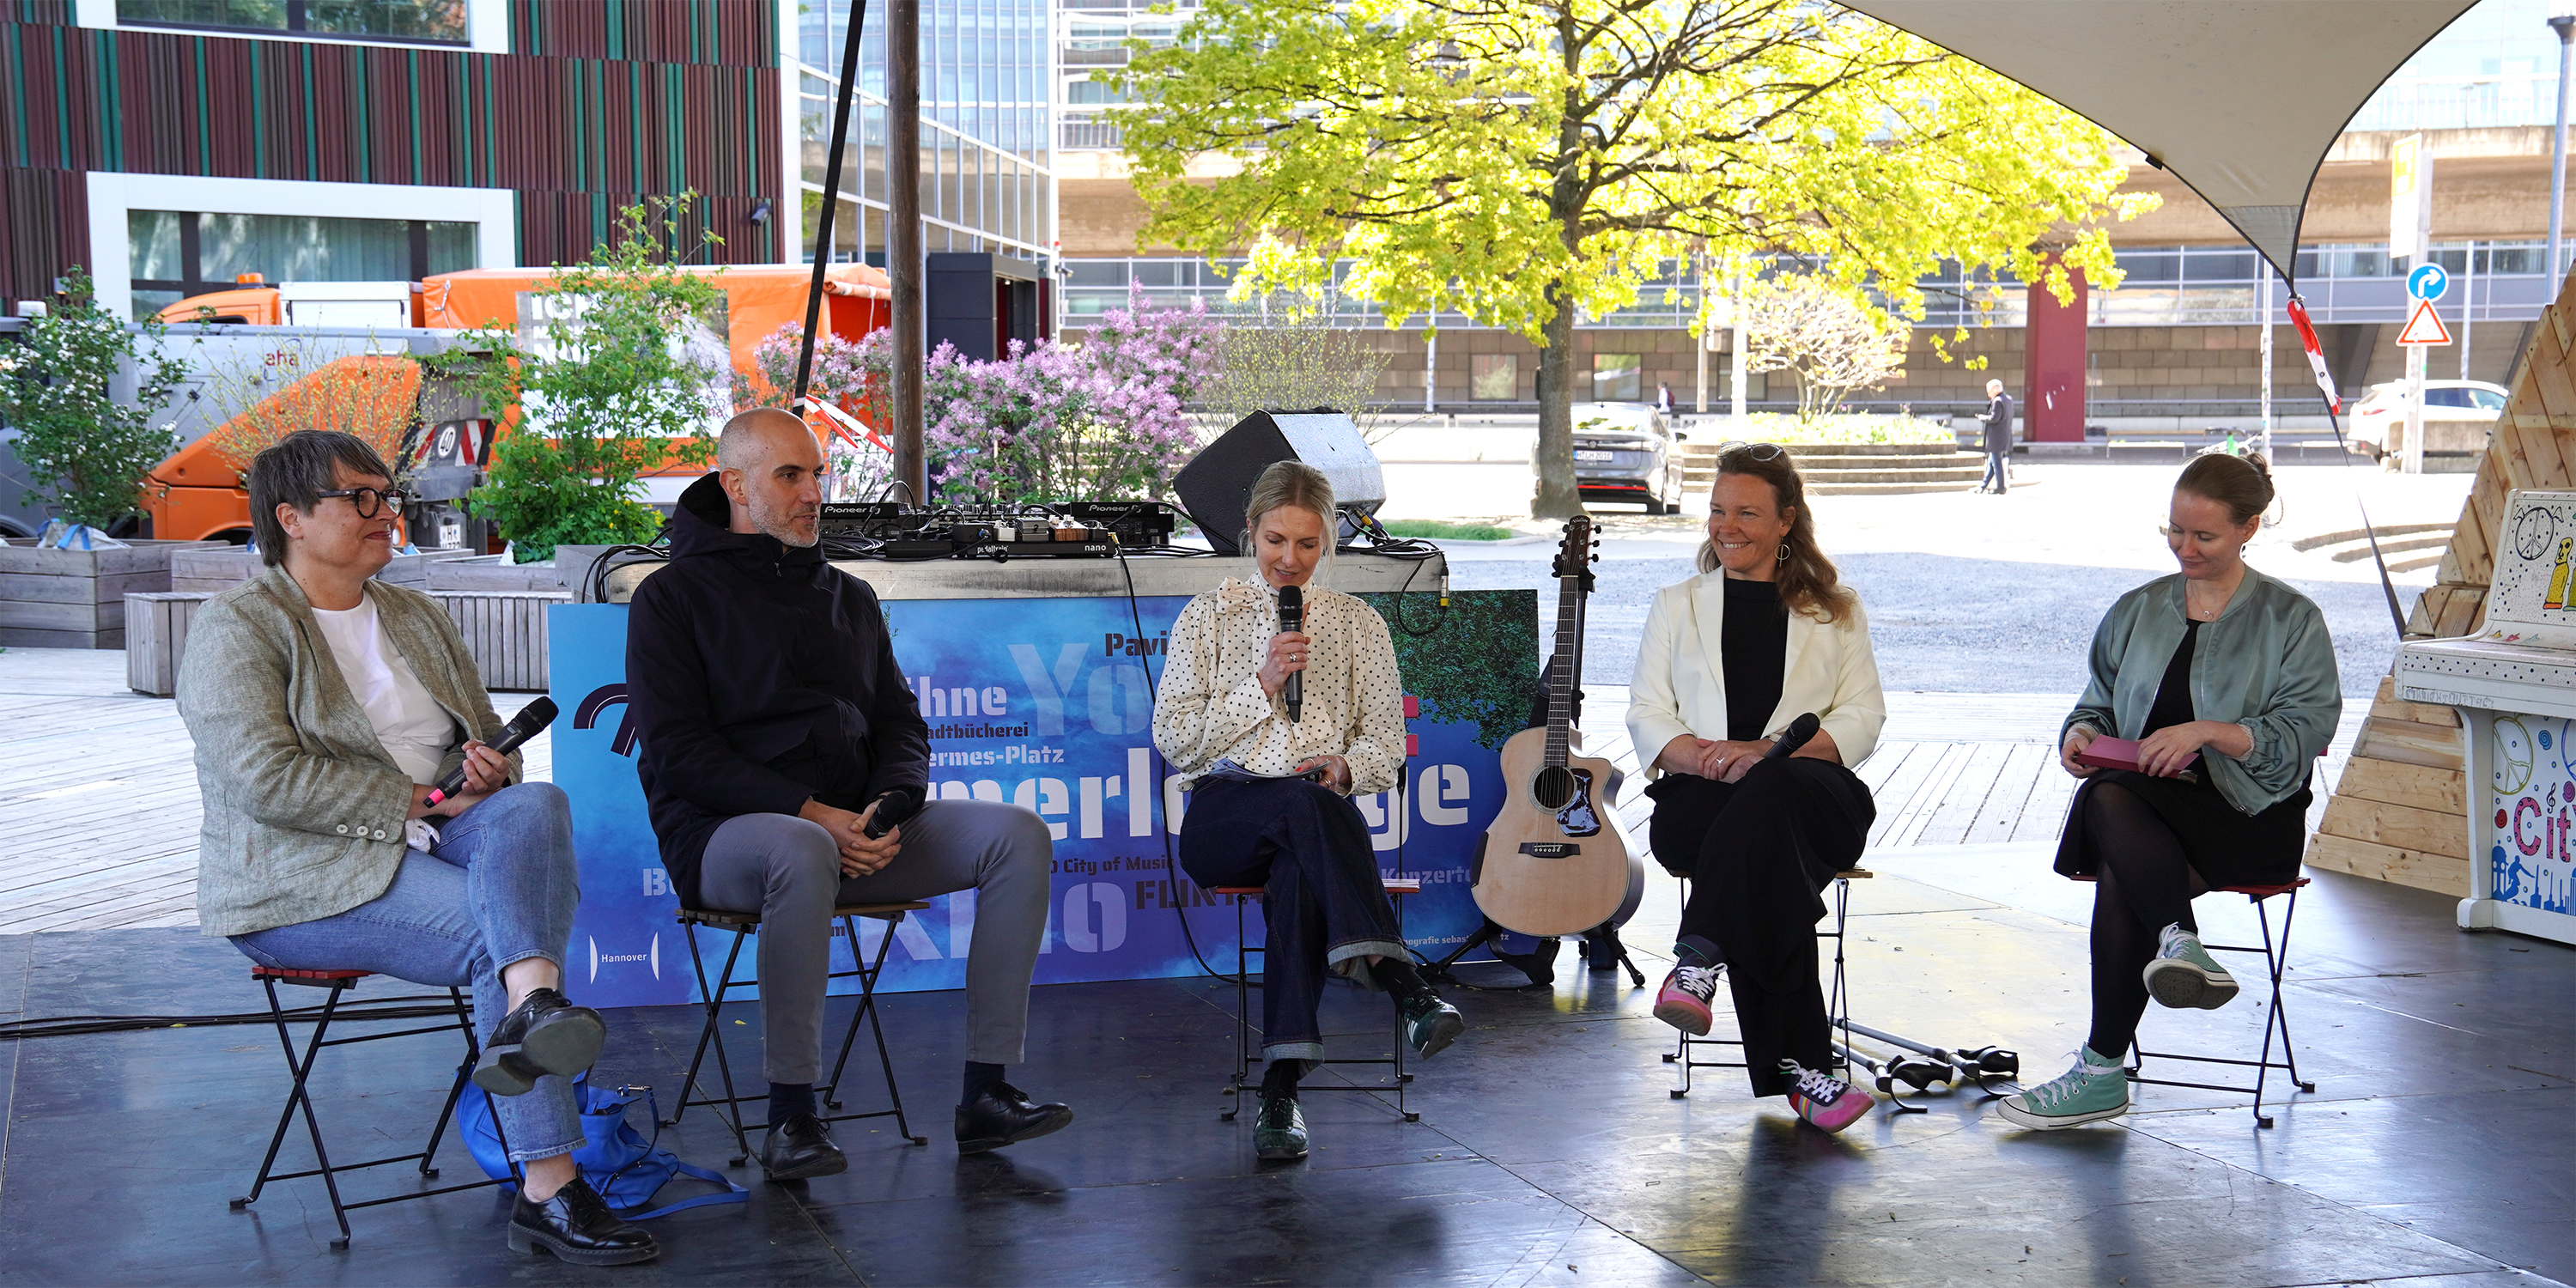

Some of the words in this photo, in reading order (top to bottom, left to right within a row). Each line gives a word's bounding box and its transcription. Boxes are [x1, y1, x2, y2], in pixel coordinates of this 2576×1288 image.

[265, 349, 300, 367] aha
[440, 431, 453, 453] 40
[1105, 630, 1170, 657] Pavi
[2513, 792, 2576, 863] Cit
[1063, 858, 1097, 876] City
[1103, 856, 1121, 872] of
[1126, 854, 1175, 871] Music
[1441, 934, 1472, 944] sebast
[601, 952, 647, 963] Hannover
